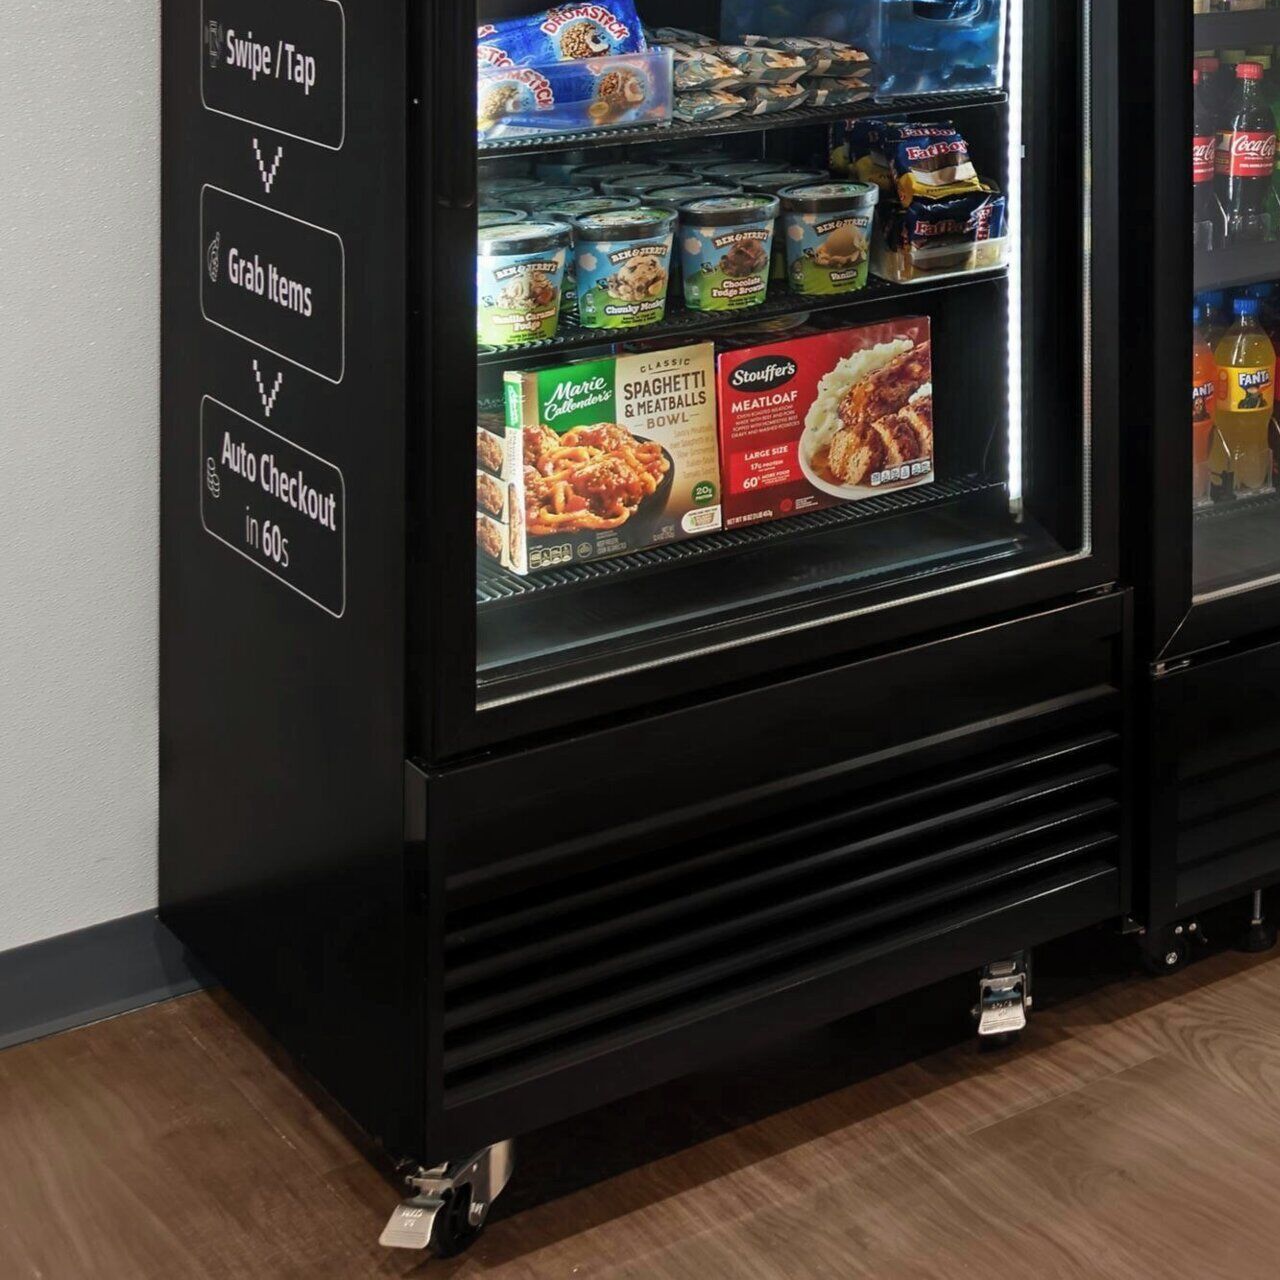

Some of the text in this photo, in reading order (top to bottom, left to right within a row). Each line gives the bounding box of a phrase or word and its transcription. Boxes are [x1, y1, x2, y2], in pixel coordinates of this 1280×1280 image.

[226, 29, 316, 95] Swipe / Tap
[907, 140, 968, 160] FatBoy
[714, 236, 736, 248] BEN
[611, 250, 632, 263] BEN
[228, 247, 312, 317] Grab Items
[496, 266, 517, 279] BEN
[605, 303, 641, 316] Chunky
[640, 358, 691, 373] CLASSIC
[732, 362, 796, 386] Stouffer's
[544, 377, 607, 407] Marie
[623, 371, 706, 400] SPAGHETTI
[1192, 382, 1214, 399] ANTA
[544, 388, 613, 421] Callender's
[625, 391, 707, 418] & MEATBALLS
[731, 391, 798, 413] MEATLOAF
[647, 413, 689, 429] BOWL
[744, 445, 788, 460] LARGE SIZE
[221, 431, 336, 532] Auto Checkout
[246, 505, 289, 568] in 60s
